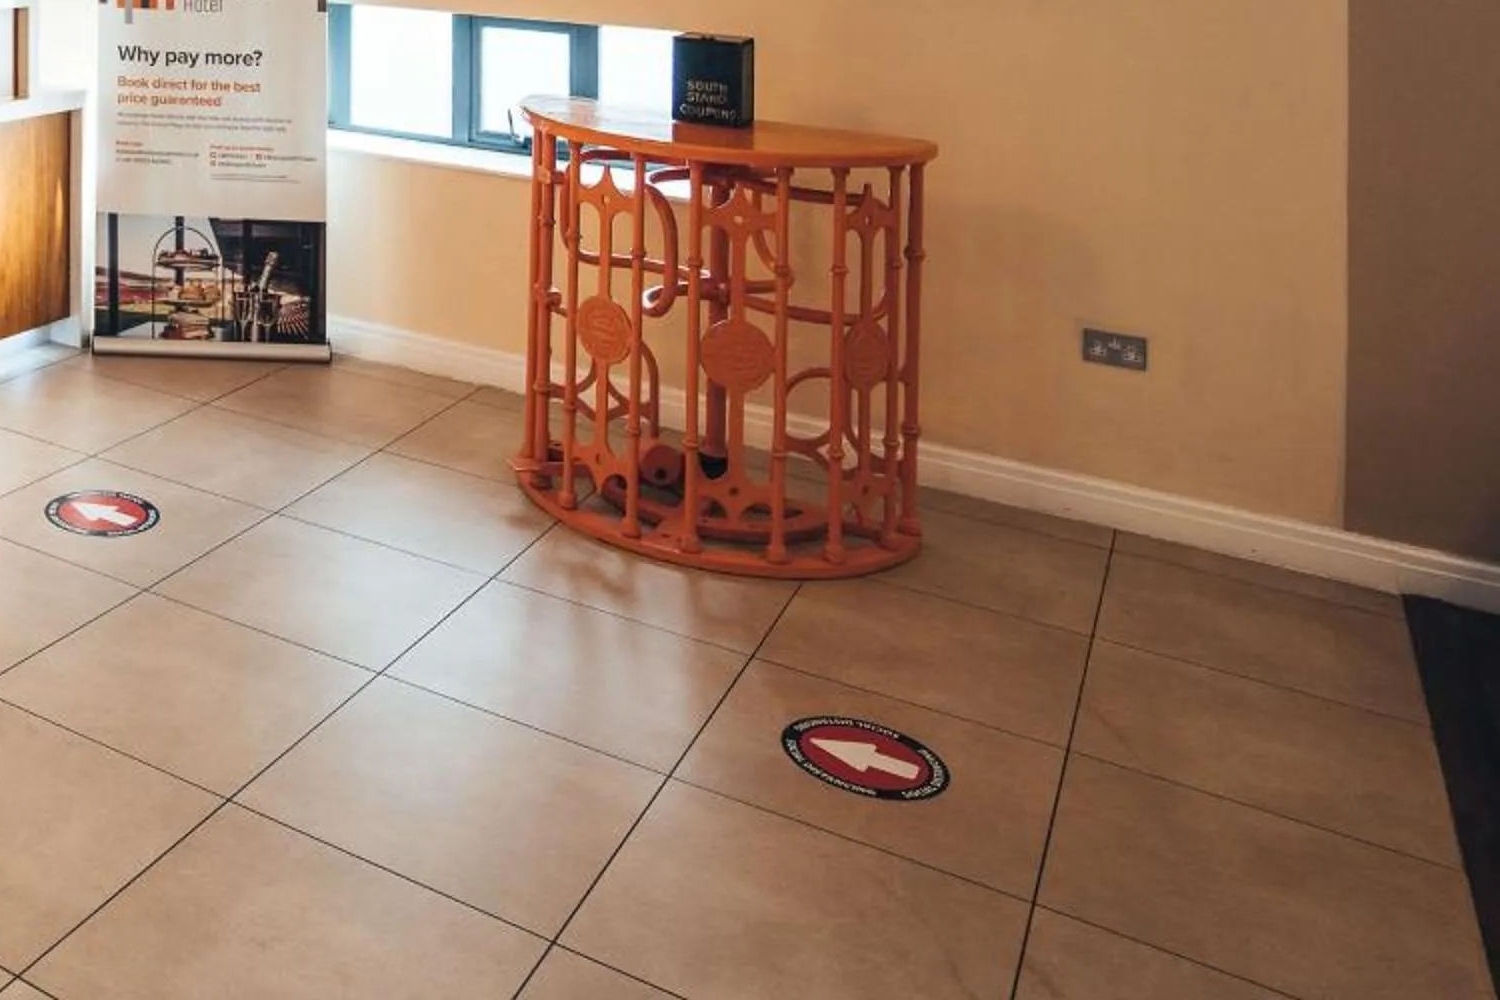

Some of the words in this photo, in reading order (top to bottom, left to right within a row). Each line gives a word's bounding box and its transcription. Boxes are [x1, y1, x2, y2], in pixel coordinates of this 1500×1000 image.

[117, 45, 160, 67] Why
[165, 51, 200, 68] pay
[204, 50, 264, 67] more?
[117, 75, 150, 88] Book
[151, 77, 188, 90] direct
[190, 79, 210, 91] for
[211, 80, 232, 92] the
[233, 81, 262, 93] best
[116, 92, 148, 106] price
[150, 94, 223, 107] guaranteed
